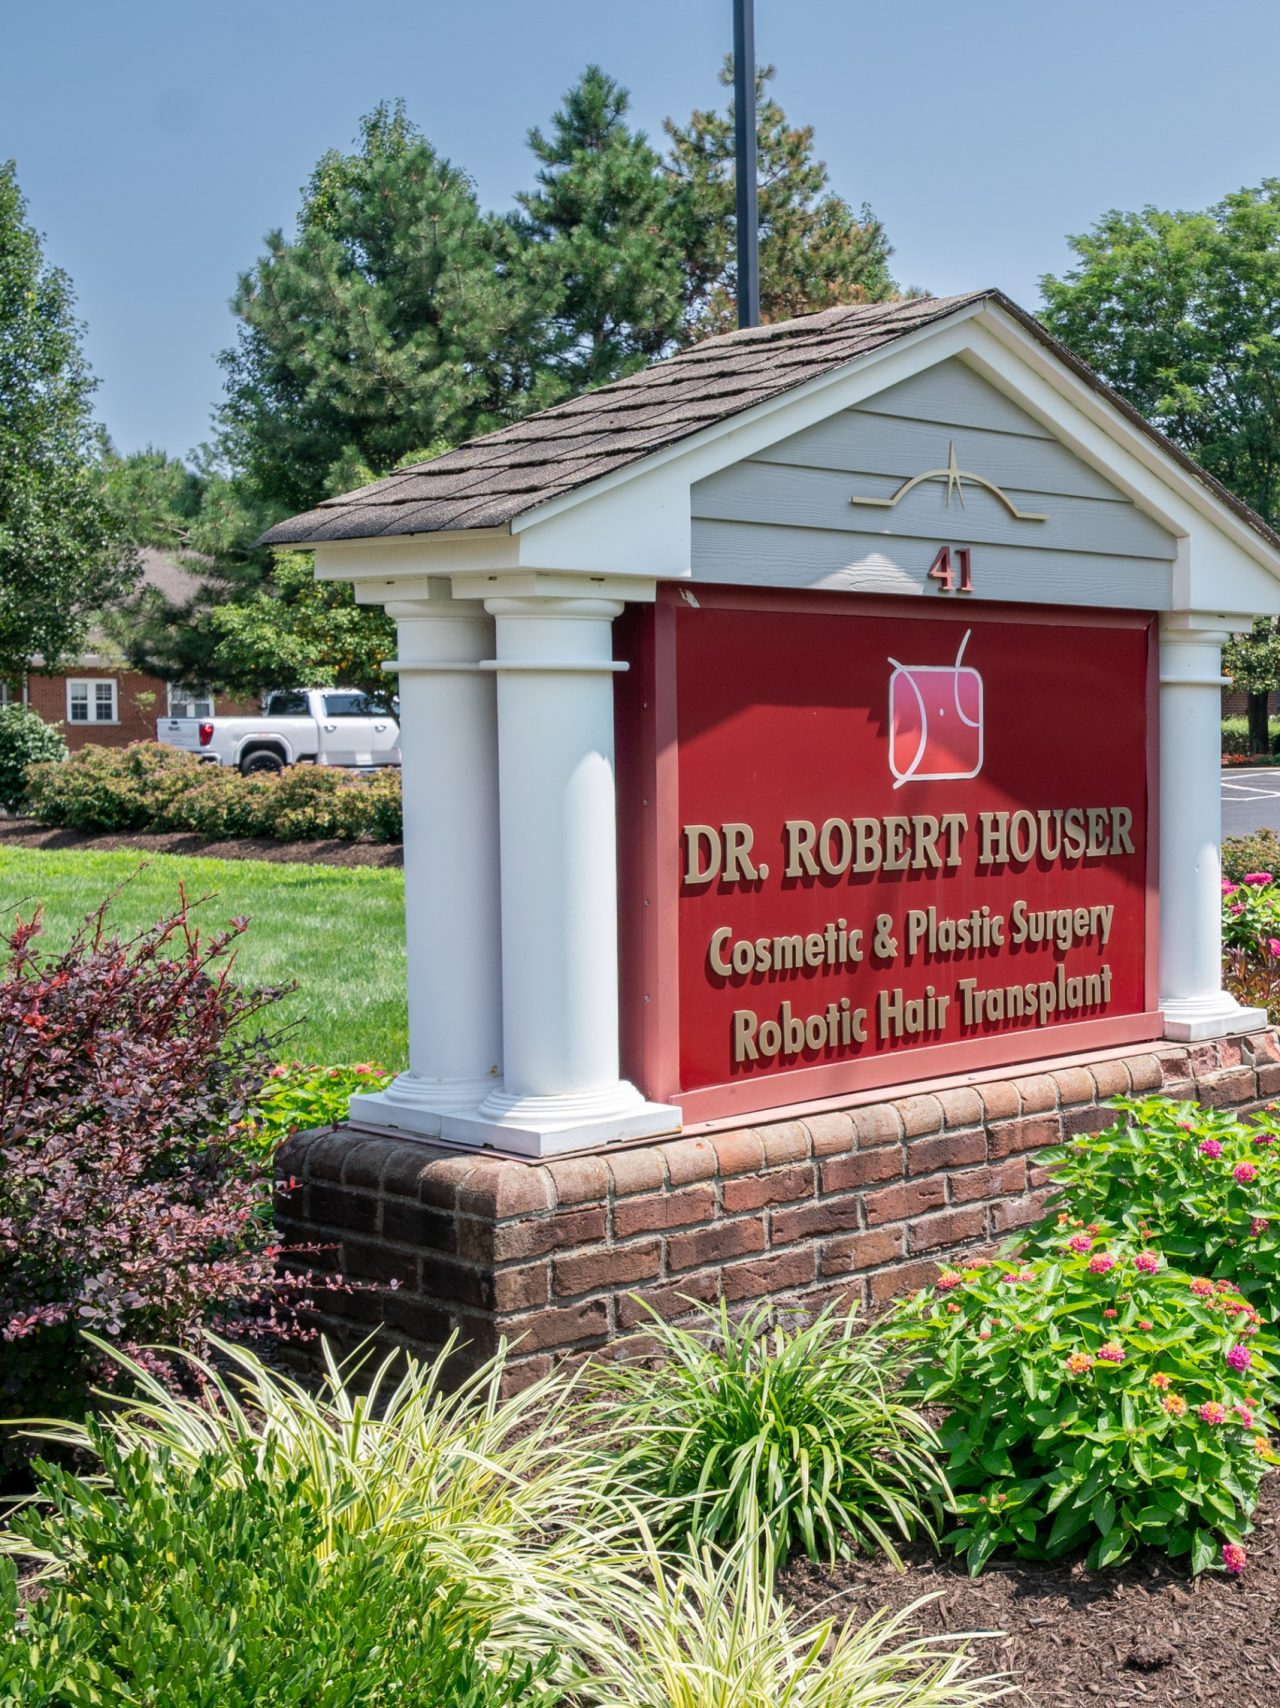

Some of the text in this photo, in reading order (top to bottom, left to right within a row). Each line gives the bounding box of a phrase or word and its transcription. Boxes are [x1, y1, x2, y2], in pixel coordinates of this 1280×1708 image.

[927, 546, 974, 592] 41
[683, 806, 1135, 884] DR. ROBERT HOUSER
[709, 900, 1115, 976] Cosmetic & Plastic Surgery
[733, 963, 1113, 1062] Robotic Hair Transplant
